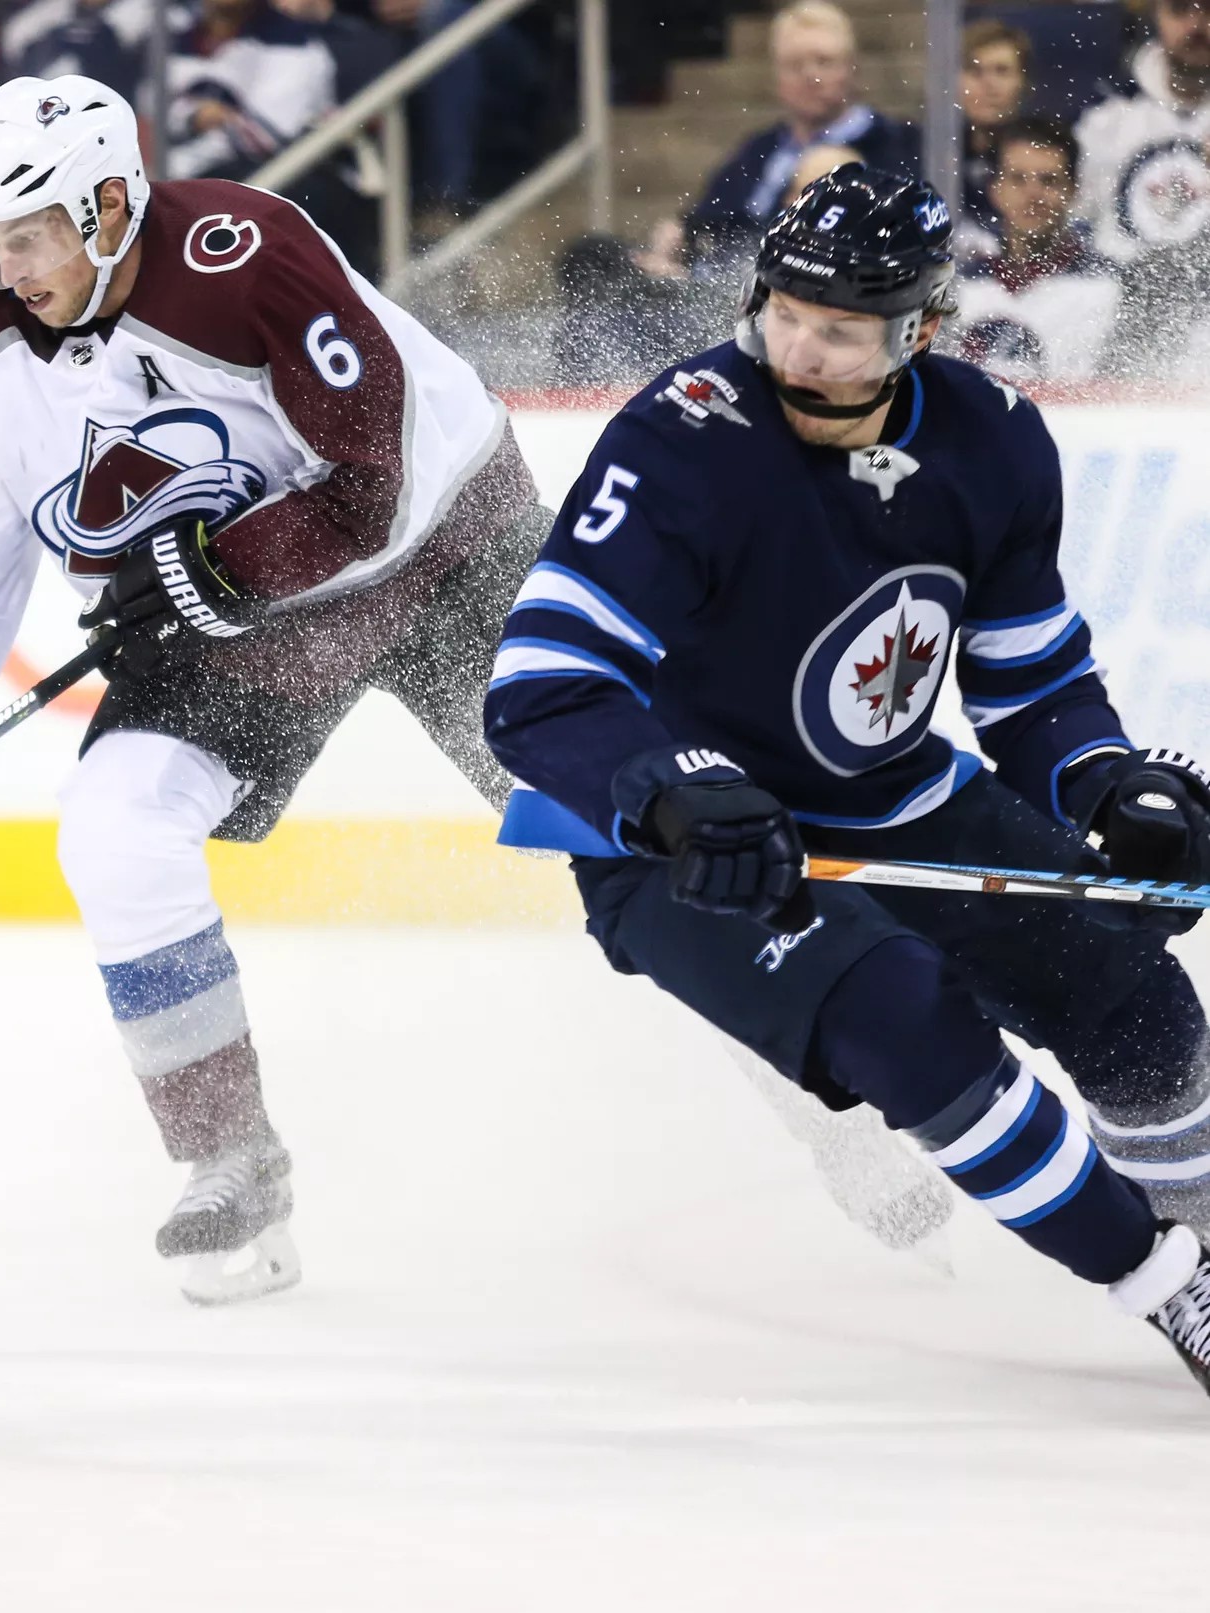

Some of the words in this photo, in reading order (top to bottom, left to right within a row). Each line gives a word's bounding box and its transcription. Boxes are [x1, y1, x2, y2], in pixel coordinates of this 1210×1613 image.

[817, 205, 845, 231] 5
[134, 353, 177, 400] A
[303, 311, 363, 391] 6
[572, 463, 640, 544] 5
